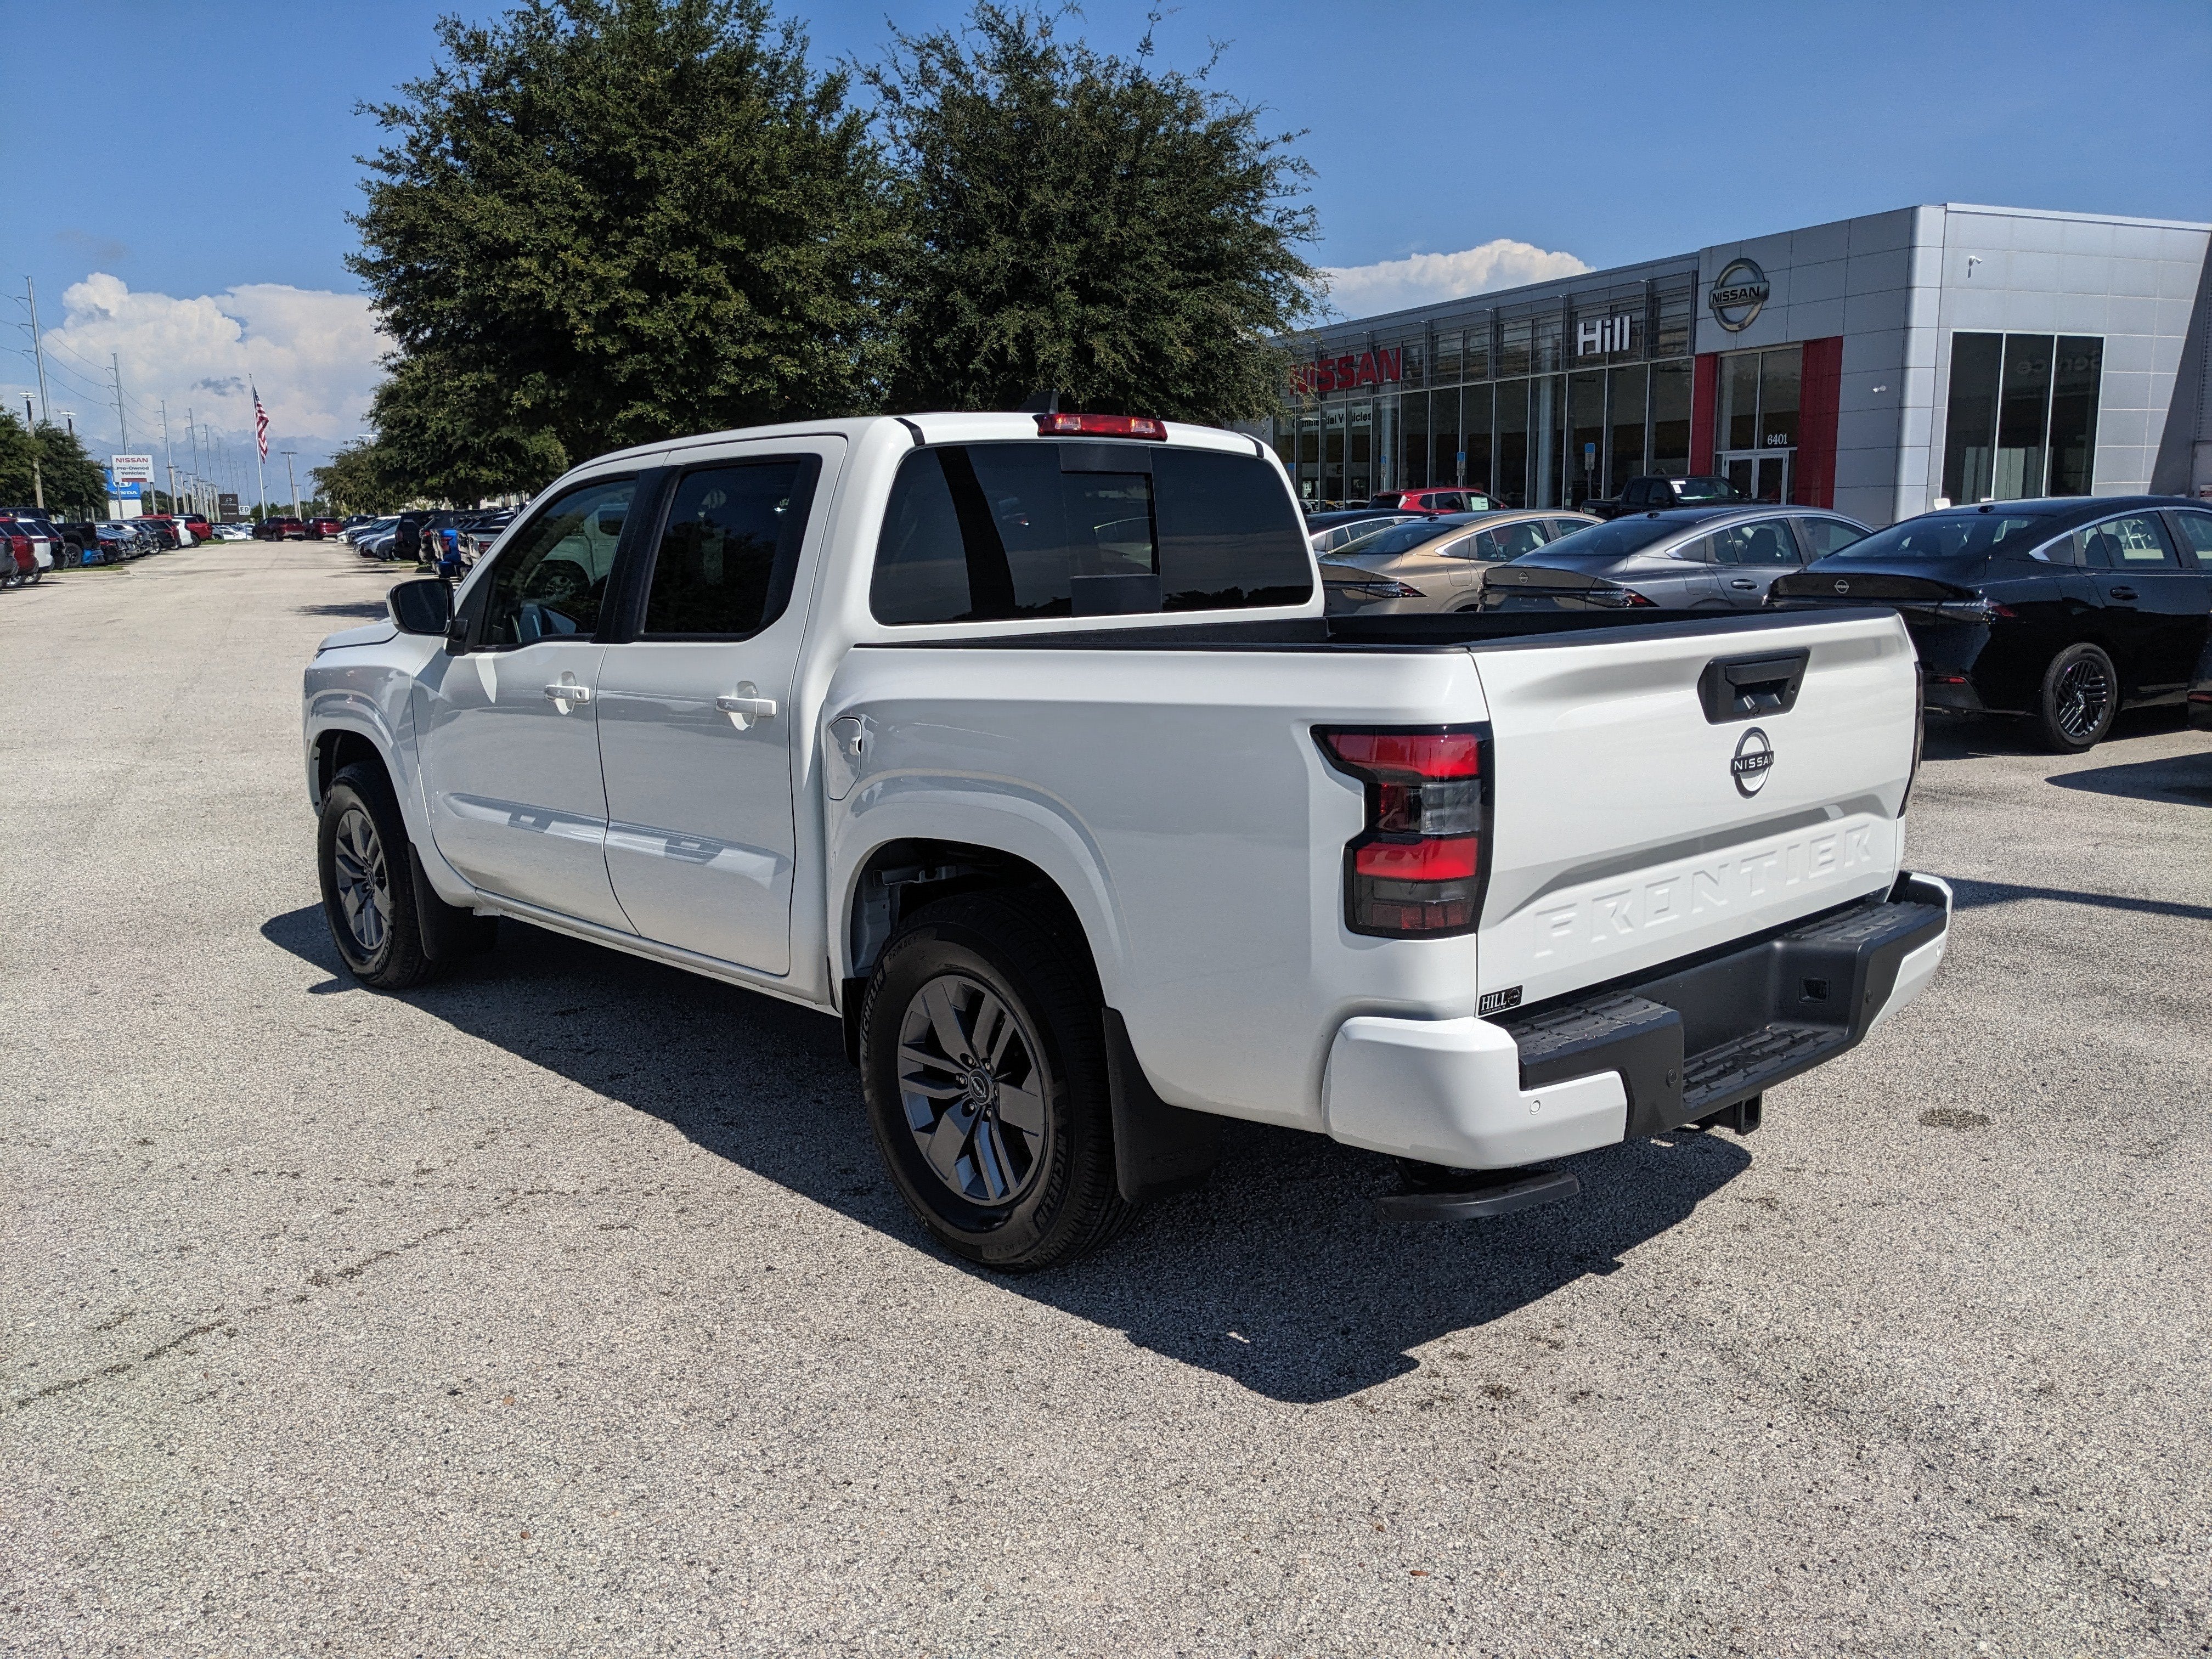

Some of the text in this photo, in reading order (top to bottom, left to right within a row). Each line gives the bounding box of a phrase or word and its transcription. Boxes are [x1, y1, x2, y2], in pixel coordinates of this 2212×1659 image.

[1712, 286, 1760, 304] NISSAN
[1577, 315, 1630, 357] Hill
[1289, 347, 1402, 396] NISSAN
[1767, 433, 1787, 445] 6401
[1734, 753, 1774, 771] NISSAN
[1534, 823, 1871, 958] FRONTIER
[861, 967, 885, 1061] MICHELIN
[1480, 991, 1507, 1011] HILL
[1035, 1132, 1067, 1229] MICHELIN
